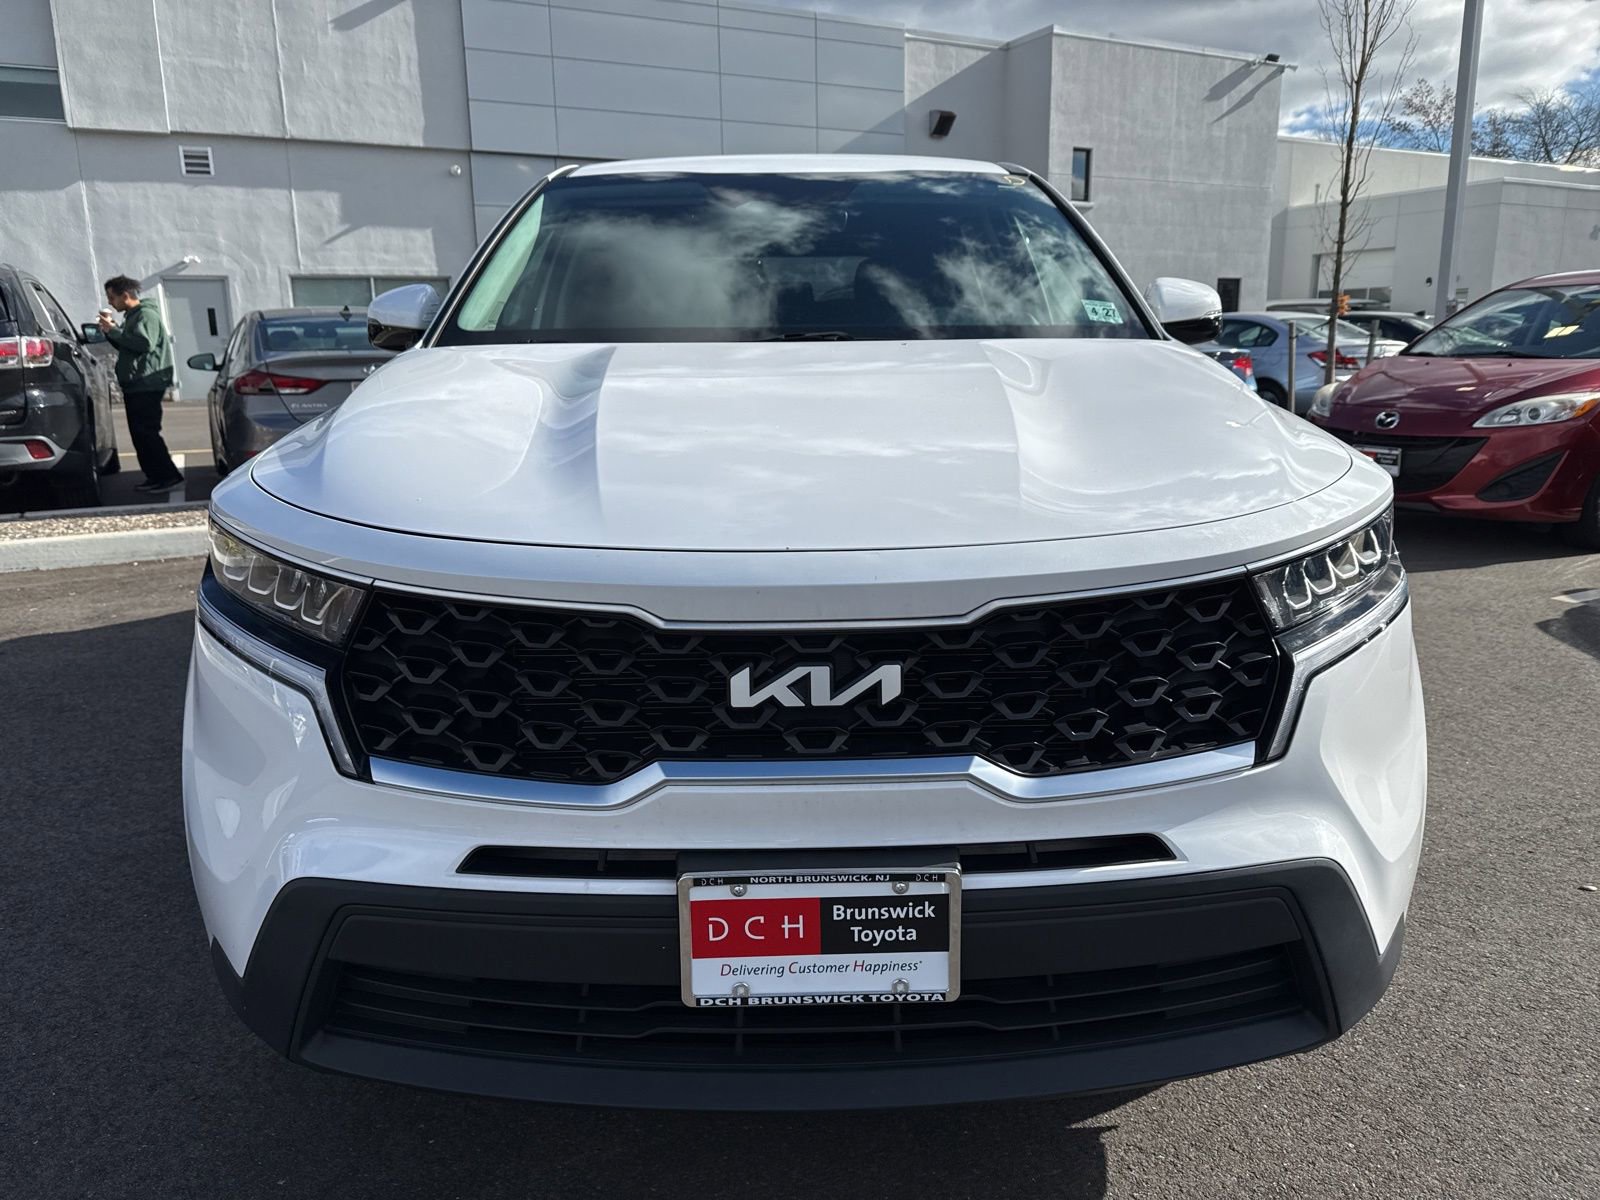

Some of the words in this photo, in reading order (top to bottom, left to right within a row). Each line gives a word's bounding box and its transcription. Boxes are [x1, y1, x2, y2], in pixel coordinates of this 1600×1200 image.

[1091, 307, 1099, 316] 4
[1102, 307, 1116, 318] 27
[730, 664, 902, 708] KIA
[749, 876, 793, 884] NORTH
[875, 874, 891, 882] NJ
[832, 901, 936, 921] Brunswick
[850, 925, 918, 947] Toyota
[720, 963, 785, 978] Delivering
[788, 961, 850, 974] Customer
[852, 960, 919, 975] Happiness
[700, 997, 742, 1006] DCH
[747, 993, 865, 1005] BRUNSWICK
[868, 992, 945, 1002] TOYOTA
